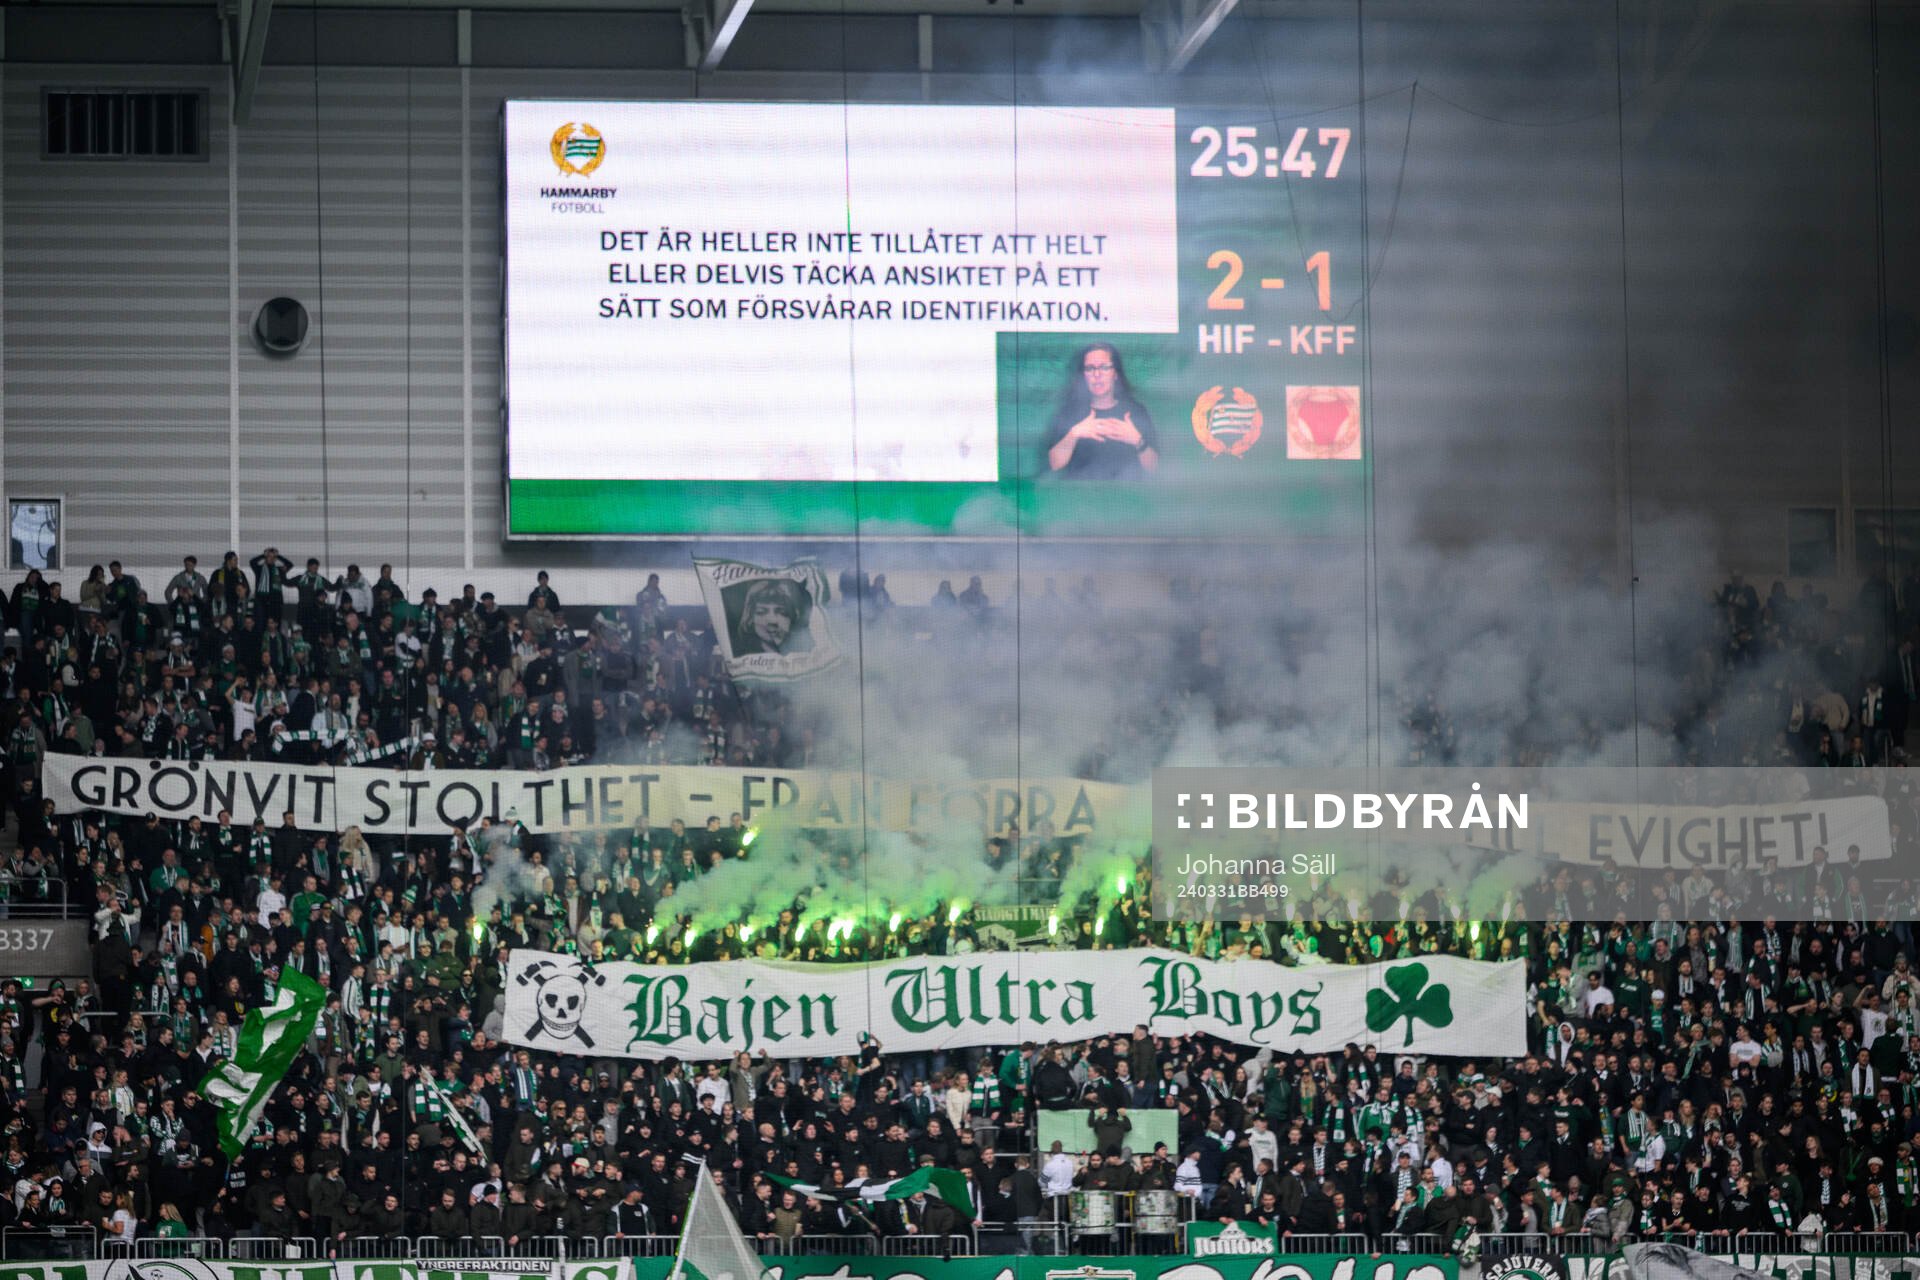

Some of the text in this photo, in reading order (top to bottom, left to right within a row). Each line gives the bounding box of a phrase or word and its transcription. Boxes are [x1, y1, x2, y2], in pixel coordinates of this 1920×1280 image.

[1190, 126, 1351, 178] 25:47
[540, 187, 617, 199] HAMMARBY
[551, 201, 605, 214] FOTBOLL
[600, 226, 1107, 255] DET ÄR HELLER INTE TILLÅTET ATT HELT
[608, 260, 1100, 286] ELLER DELVIS TÄCKA ANSIKTET PÅ ETT
[1206, 249, 1244, 311] 2
[1306, 251, 1331, 311] 1
[598, 293, 1109, 321] SÄTT SOM FÖRSVÅRAR IDENTIFIKATION.
[1198, 324, 1256, 353] HIF
[1290, 325, 1356, 354] KFF
[70, 760, 336, 824] GRÖNVIT
[1589, 811, 1829, 866] EVIGHET!
[622, 955, 1324, 1053] Bajen Ultra Boys
[416, 1259, 551, 1272] YNGREFRAKTIONEN
